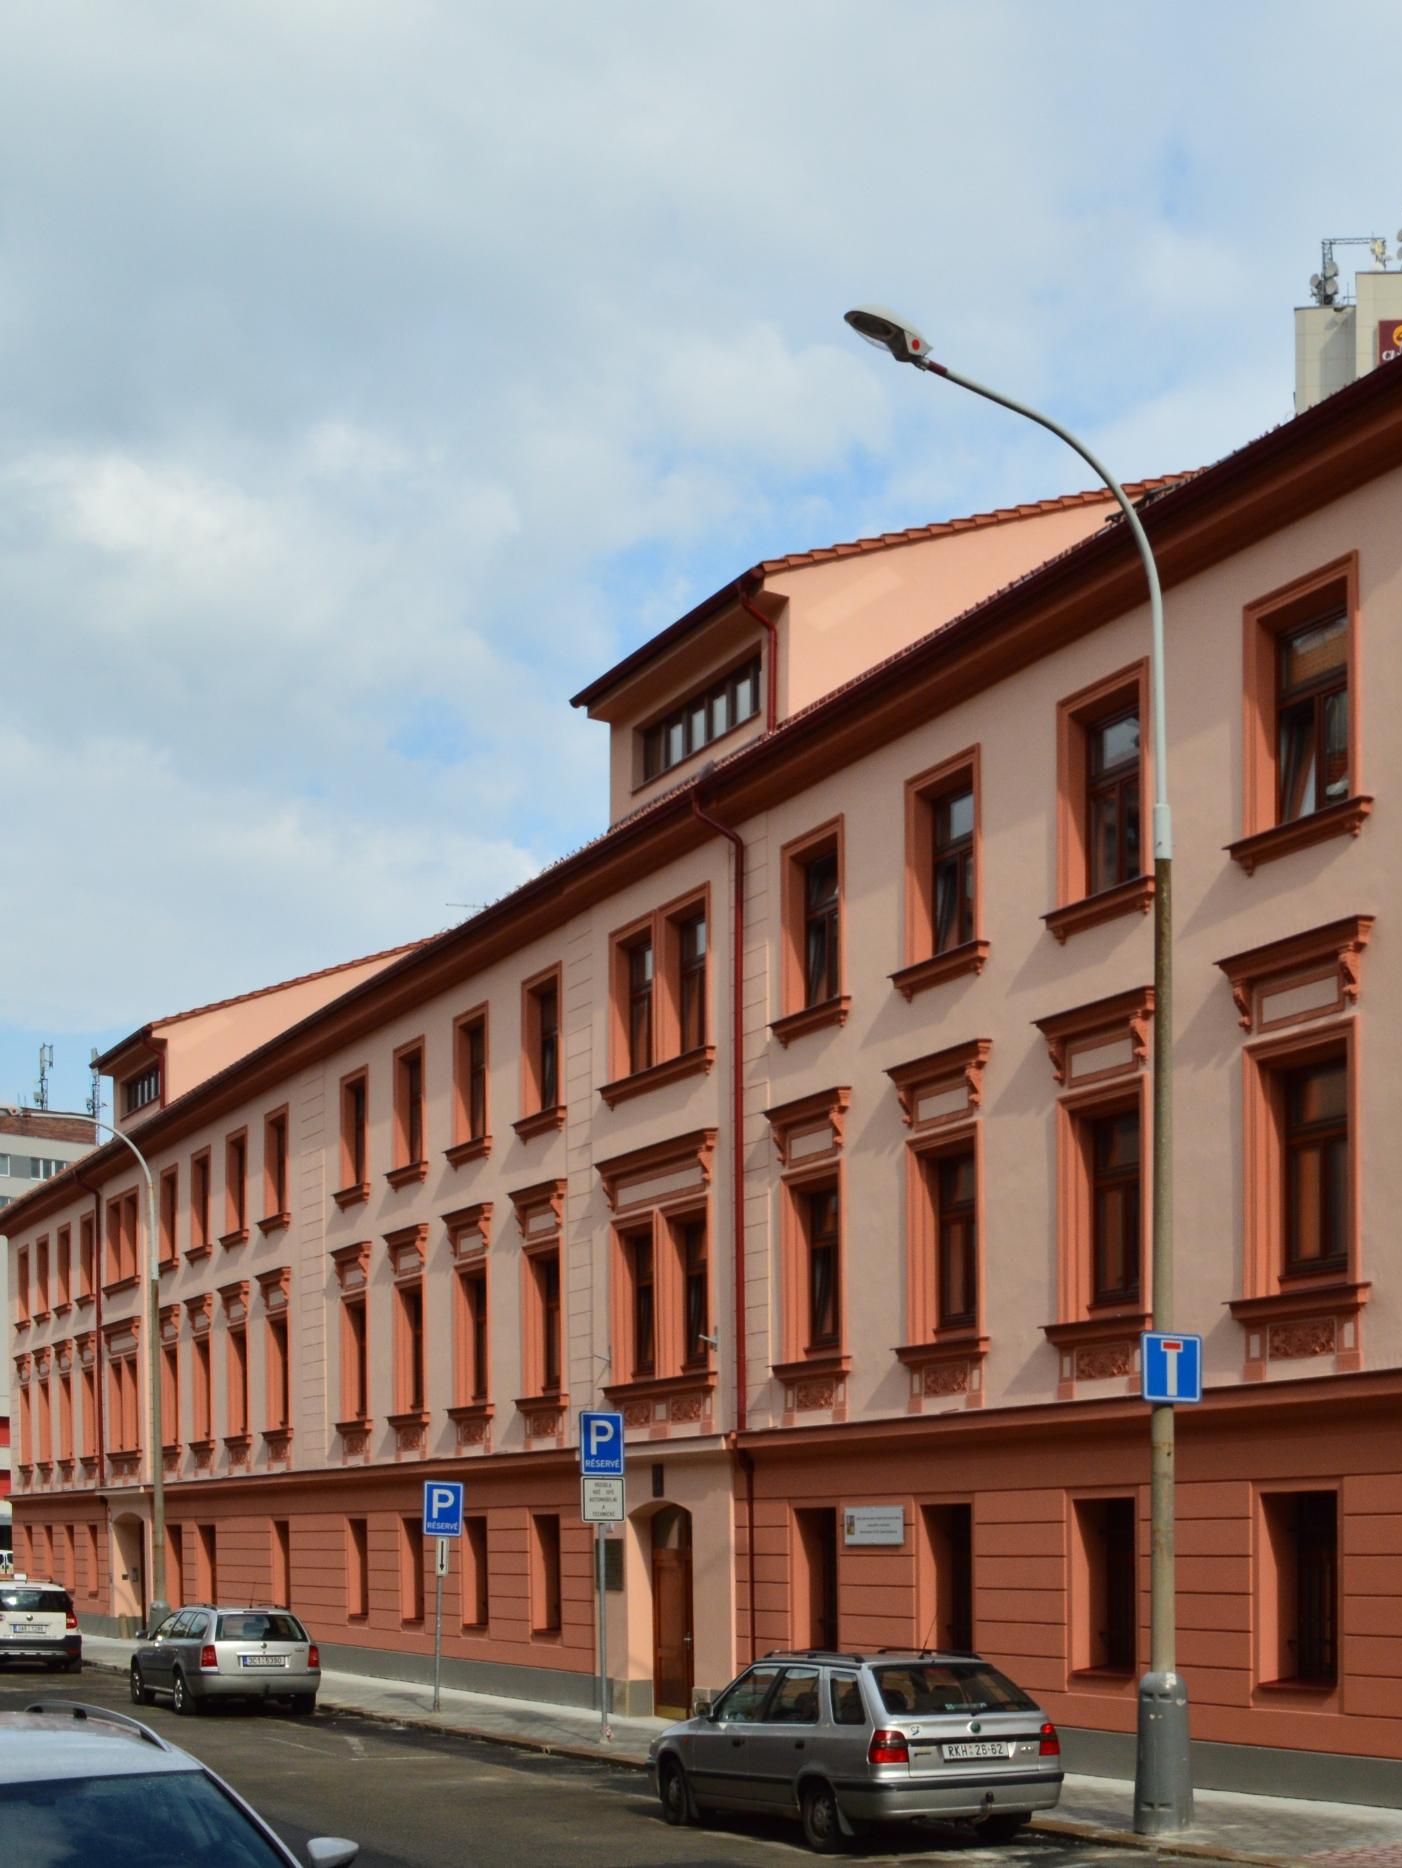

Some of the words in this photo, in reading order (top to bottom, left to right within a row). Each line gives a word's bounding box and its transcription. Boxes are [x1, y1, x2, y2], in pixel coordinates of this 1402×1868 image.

[590, 1419, 614, 1456] P
[585, 1459, 620, 1468] RÉSERVÉ
[432, 1488, 455, 1519] P
[427, 1521, 459, 1531] RÉSERVÉ
[948, 1746, 968, 1758] RKH
